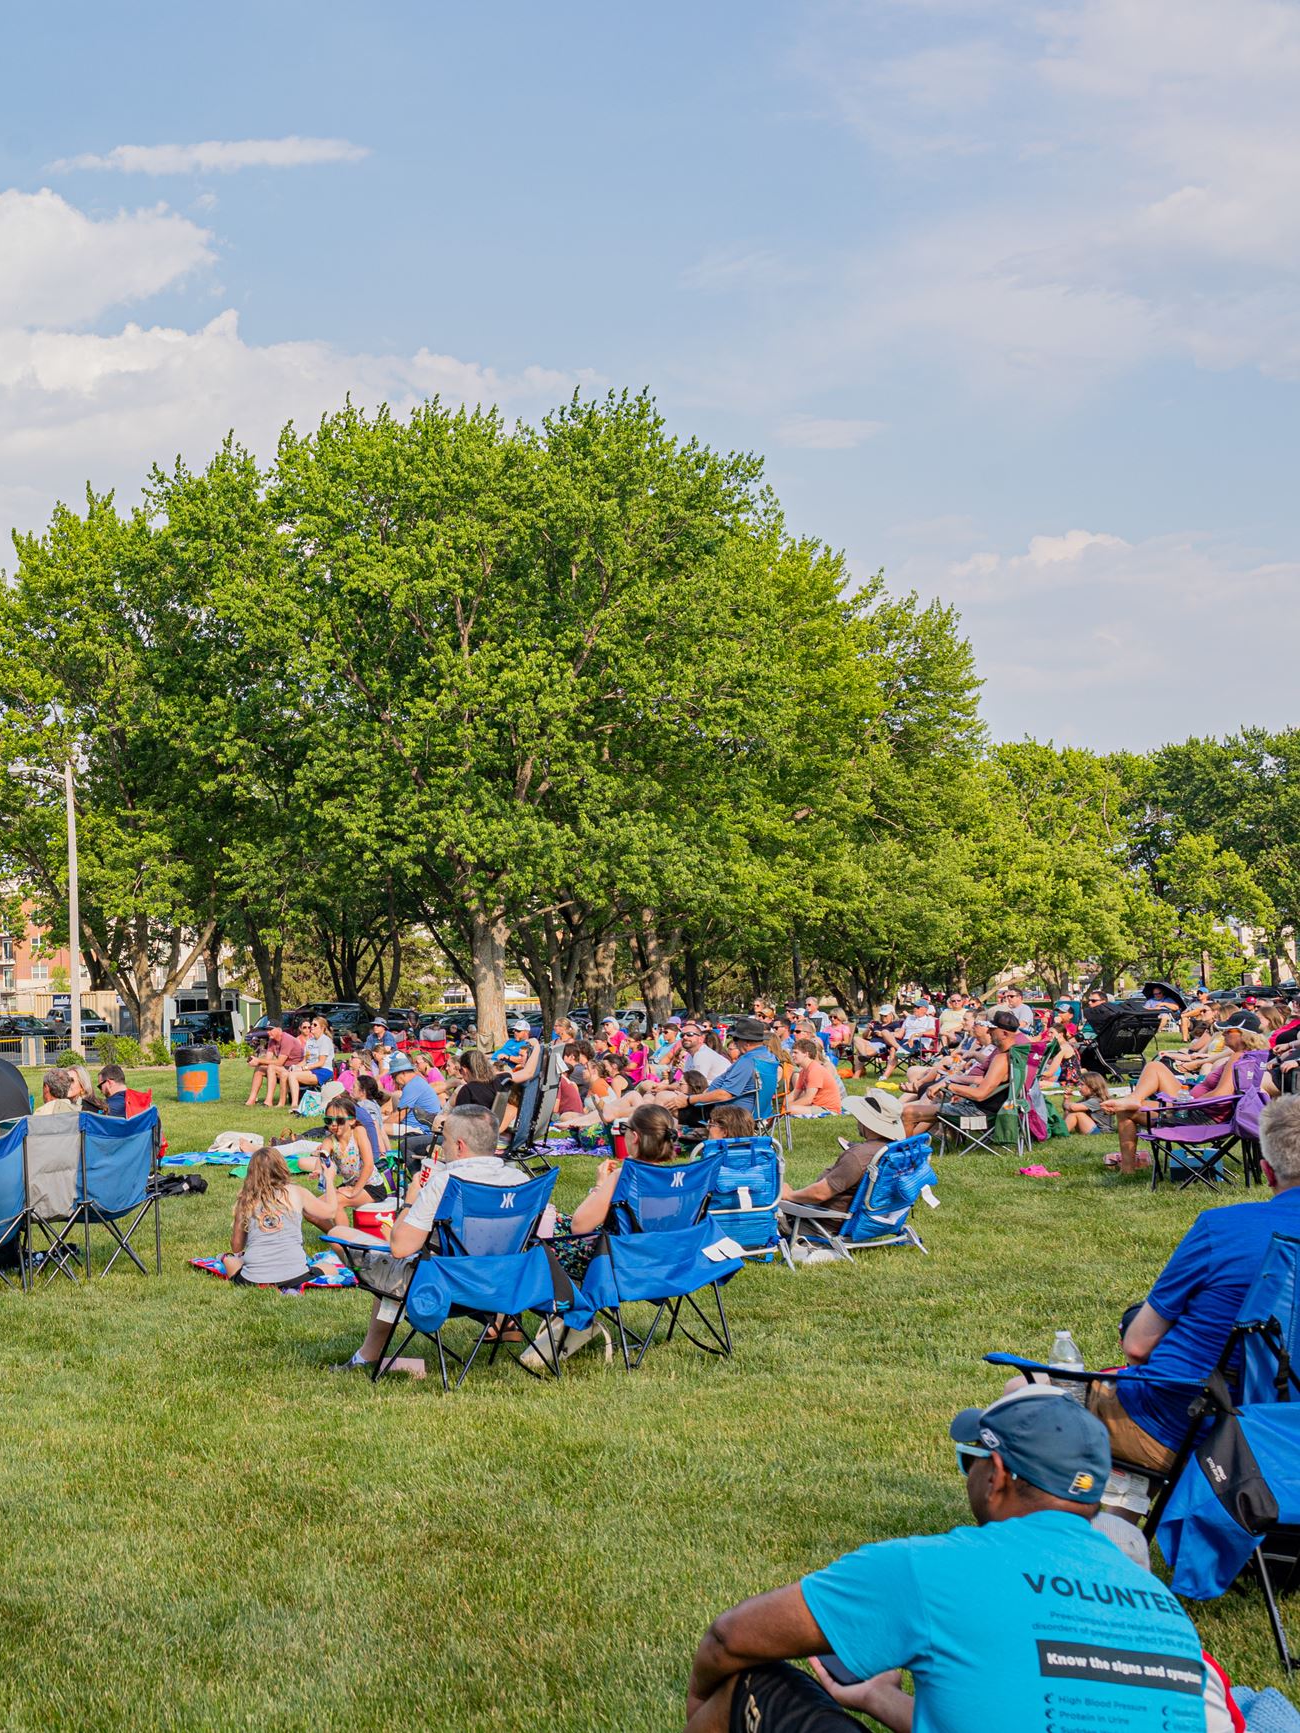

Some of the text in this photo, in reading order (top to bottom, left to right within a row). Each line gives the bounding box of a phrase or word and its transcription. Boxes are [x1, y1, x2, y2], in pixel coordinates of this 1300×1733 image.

[1046, 1652, 1088, 1668] Know
[1089, 1657, 1111, 1671] the
[1111, 1660, 1143, 1675] signs
[1143, 1666, 1166, 1678] and
[1058, 1695, 1148, 1713] High Blood Pressure
[1059, 1710, 1096, 1723] Protein
